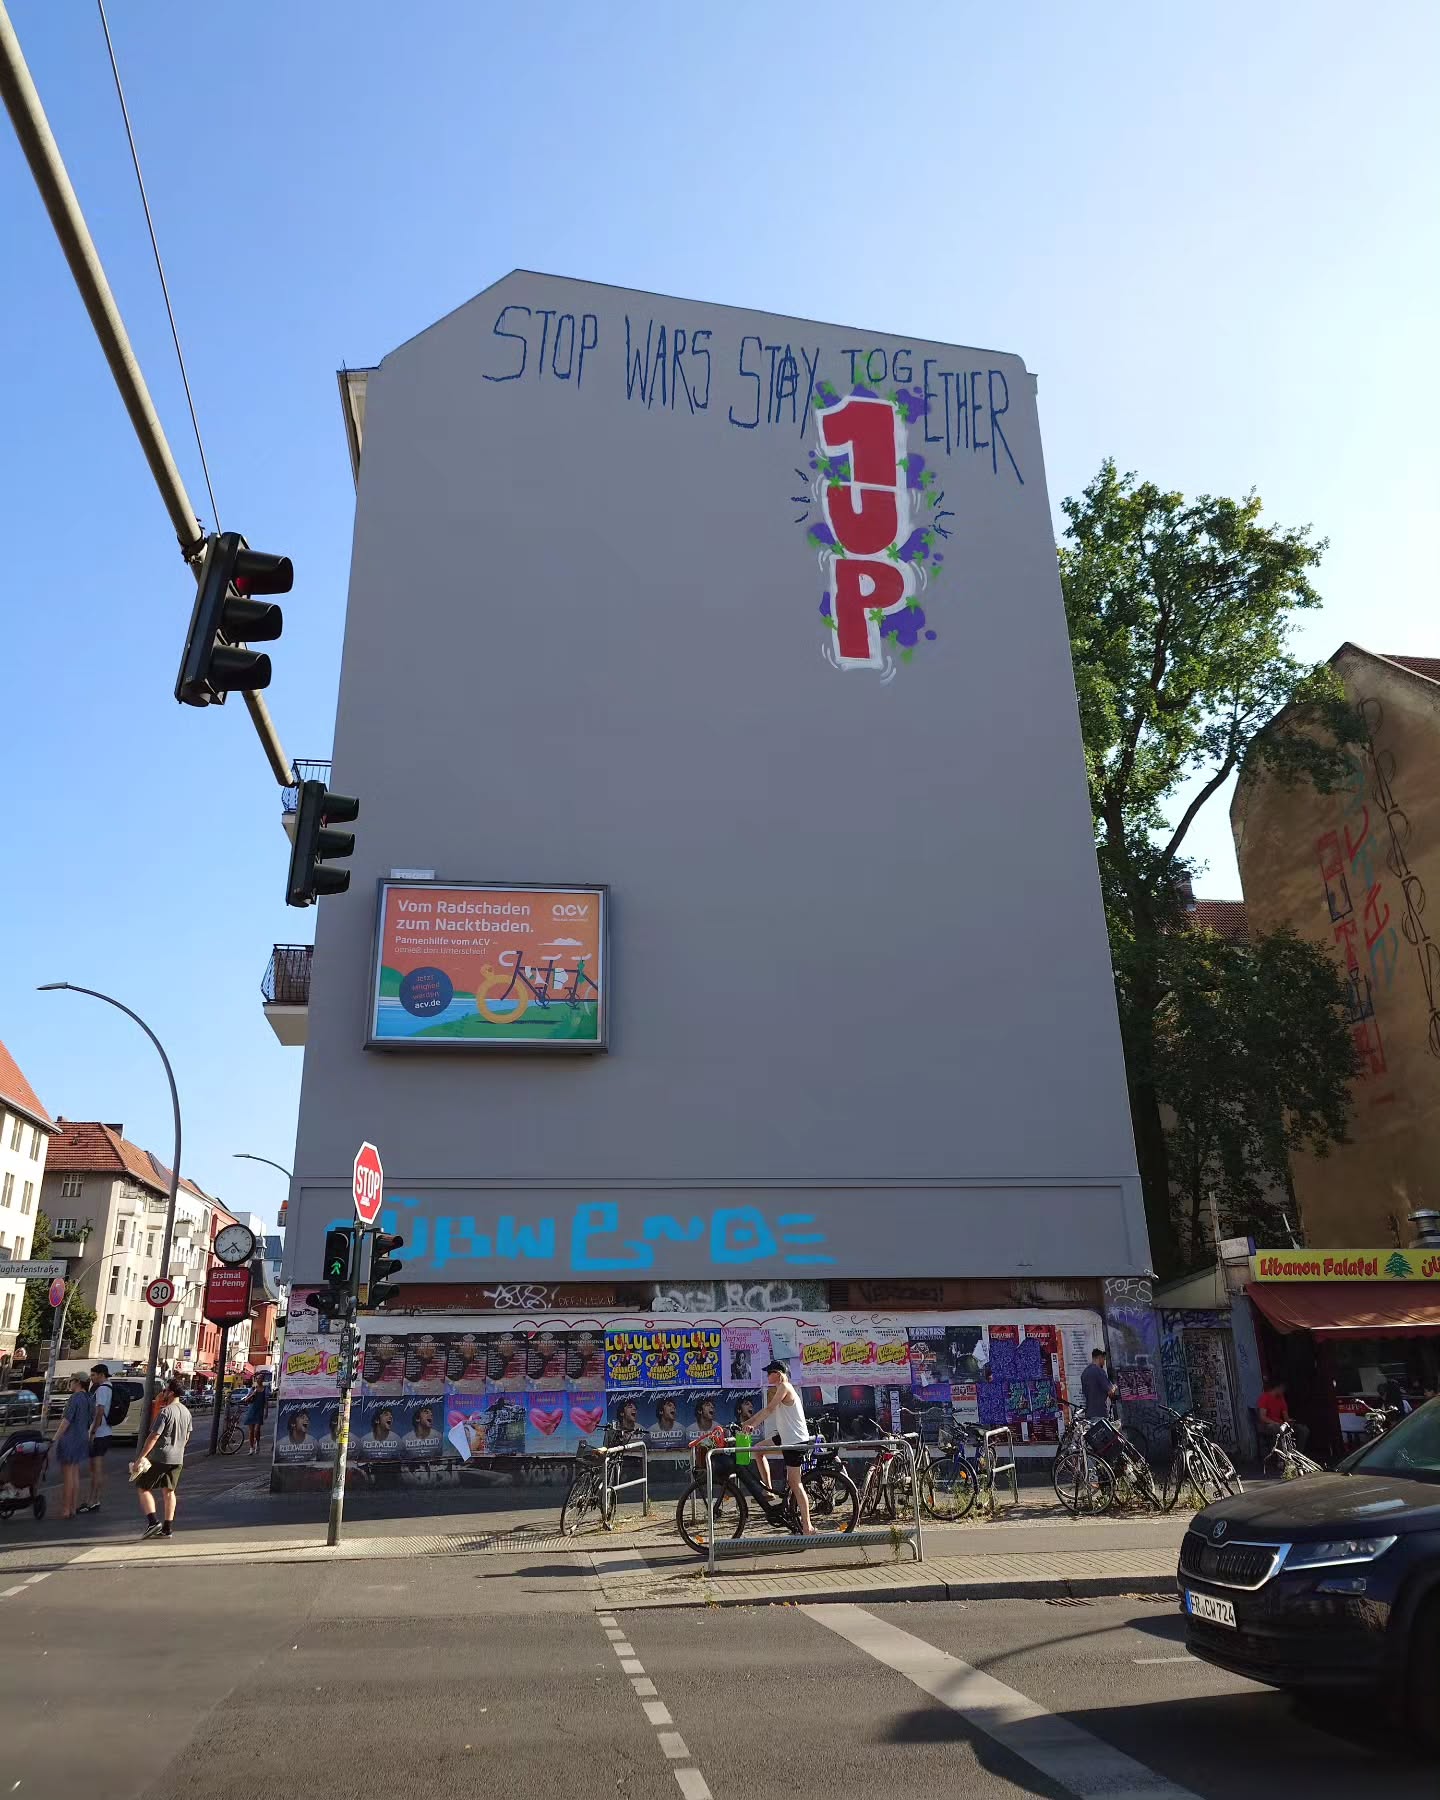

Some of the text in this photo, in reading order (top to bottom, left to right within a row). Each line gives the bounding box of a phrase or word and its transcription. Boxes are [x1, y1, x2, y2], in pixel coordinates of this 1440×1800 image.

[482, 305, 1024, 485] STOP WARS STAY TOGETHER
[815, 394, 917, 671] 1UP
[398, 899, 530, 917] Vom Radschaden
[551, 904, 589, 917] acv
[396, 919, 534, 933] zum Nacktbaden.
[395, 936, 449, 945] Pannenhilfe
[451, 938, 470, 946] vom
[472, 938, 490, 946] ACV
[414, 1000, 441, 1009] acv.de
[356, 1164, 380, 1200] STOP
[1260, 1256, 1378, 1276] Libanon Falafel
[212, 1271, 241, 1279] Erstmal
[222, 1279, 246, 1288] Penny
[151, 1286, 169, 1300] 30
[605, 1332, 643, 1351] LULU
[643, 1332, 681, 1351] LULU
[682, 1331, 721, 1349] LULU
[729, 1342, 758, 1351] Baldwin
[650, 1430, 683, 1438] ROCKWOOD
[280, 1443, 315, 1452] ROCKWOOD
[363, 1440, 398, 1449] ROCKWOOD
[405, 1437, 440, 1447] ROCKWOOD
[1191, 1594, 1202, 1613] FR
